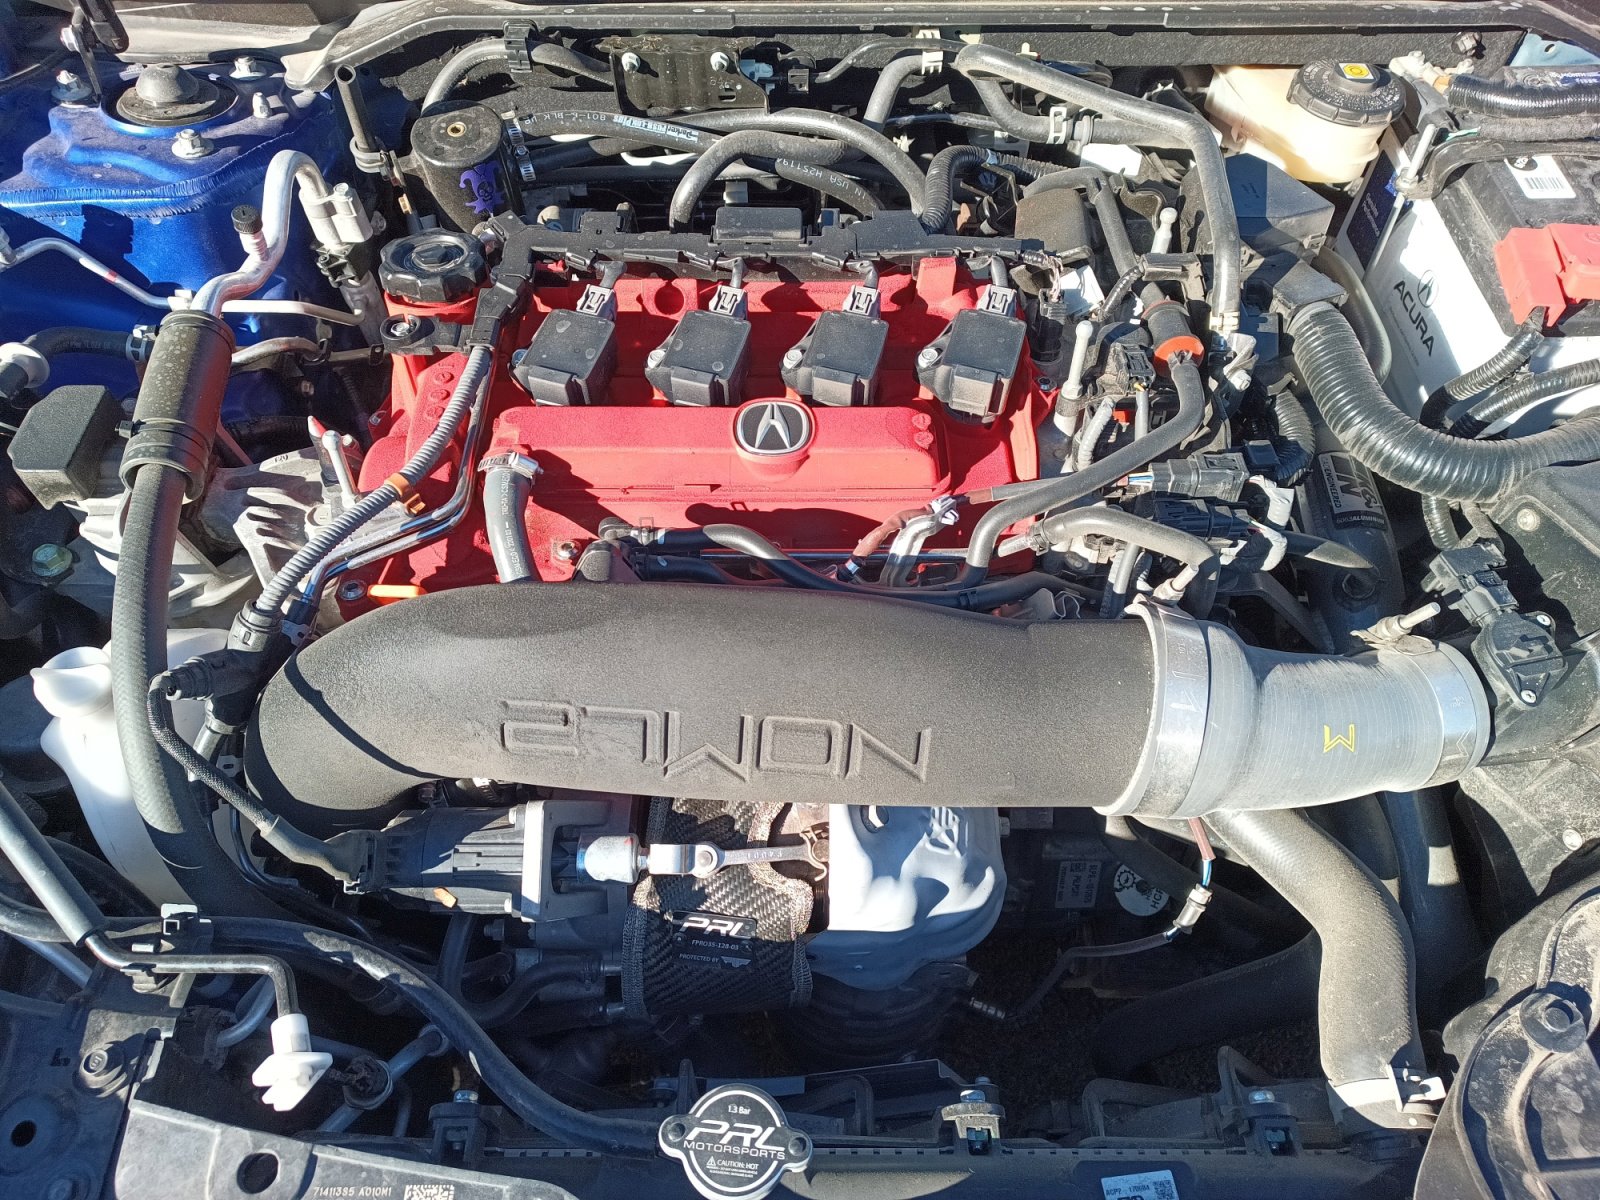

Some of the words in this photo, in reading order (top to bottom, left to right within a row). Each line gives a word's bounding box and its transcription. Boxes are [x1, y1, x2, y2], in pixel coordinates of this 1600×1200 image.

[830, 174, 849, 189] USA
[1394, 280, 1435, 356] ACURA
[501, 700, 931, 784] 27WON
[679, 916, 752, 940] PRL
[679, 953, 710, 962] PROTECTED
[738, 1105, 752, 1115] Bar
[685, 1119, 786, 1151] PRL
[683, 1140, 786, 1160] MOTORSPORTS
[717, 1159, 745, 1168] CAUTION:
[745, 1162, 760, 1170] HOT
